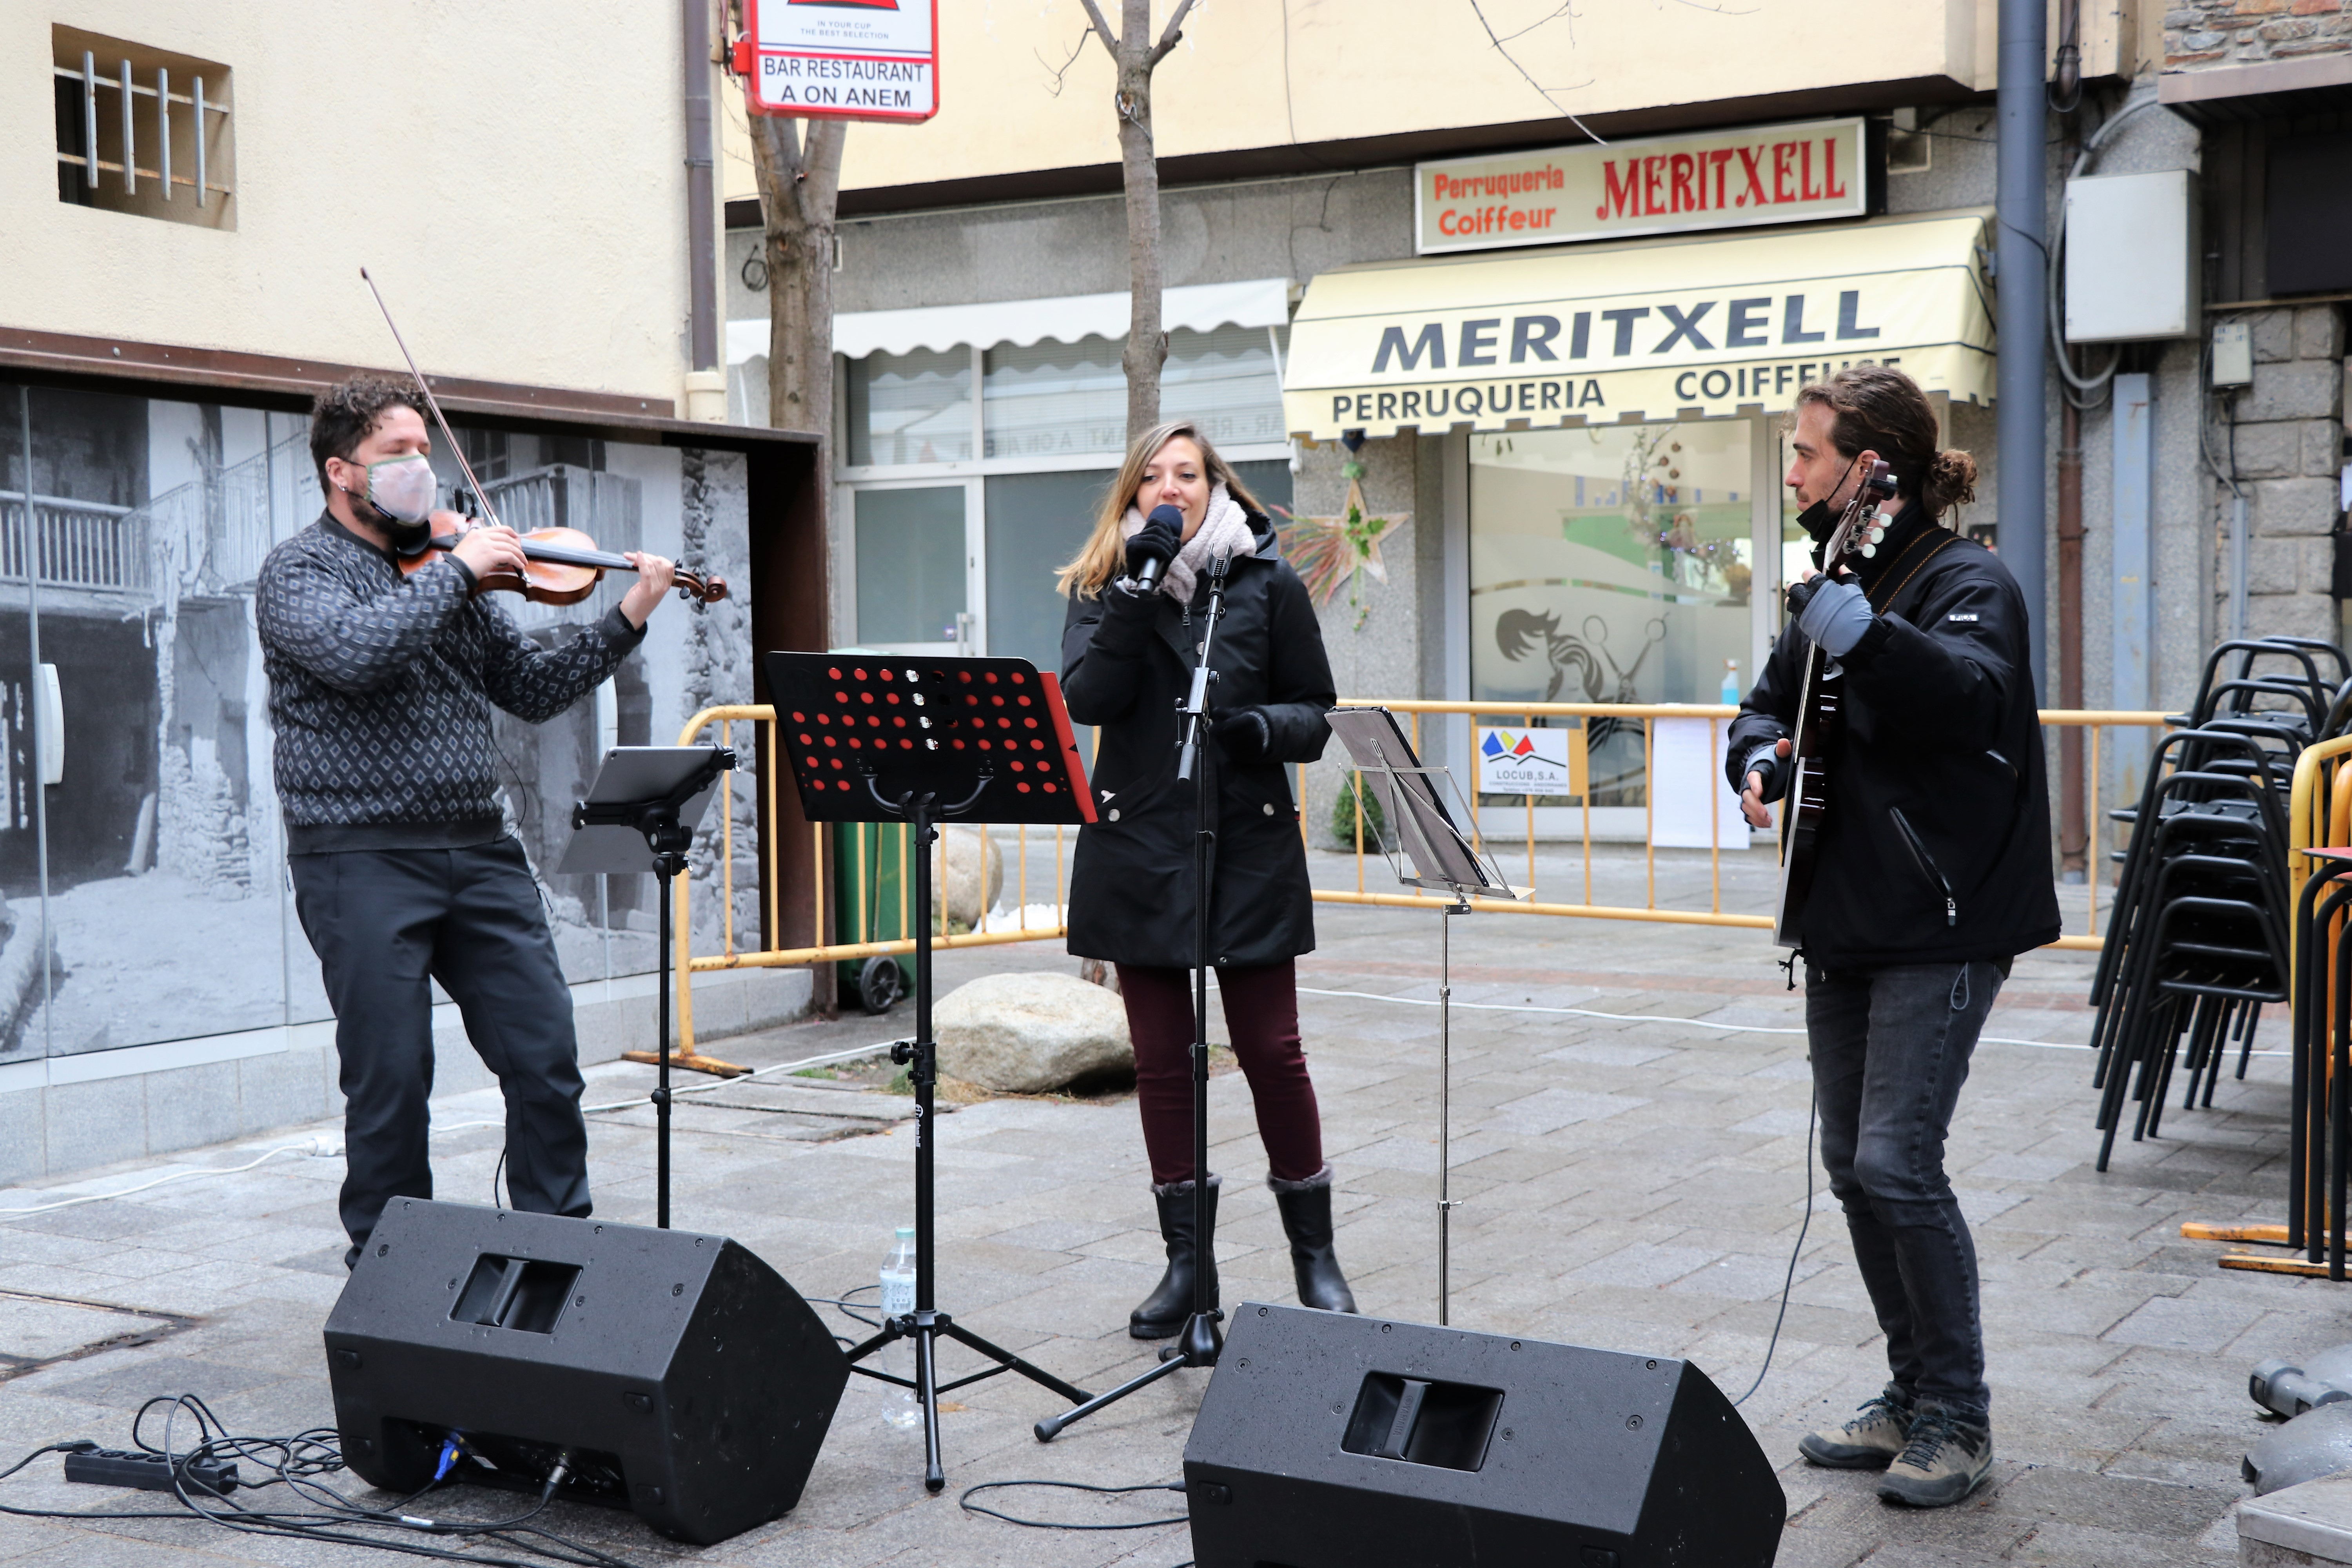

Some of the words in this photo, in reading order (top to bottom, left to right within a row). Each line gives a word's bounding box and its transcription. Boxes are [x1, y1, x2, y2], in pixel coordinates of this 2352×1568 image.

[843, 30, 889, 39] SELECTION
[765, 58, 800, 76] BAR
[808, 60, 924, 82] RESTAURANT
[781, 85, 797, 102] A
[805, 86, 837, 104] ON
[846, 88, 911, 108] ANEM
[1434, 163, 1564, 201] Perruqueria
[1596, 138, 1846, 221] MERITXELL
[1439, 205, 1557, 236] Coiffeur
[1371, 290, 1880, 373] MERITXELL
[1332, 379, 1606, 423] PERRUQUERIA
